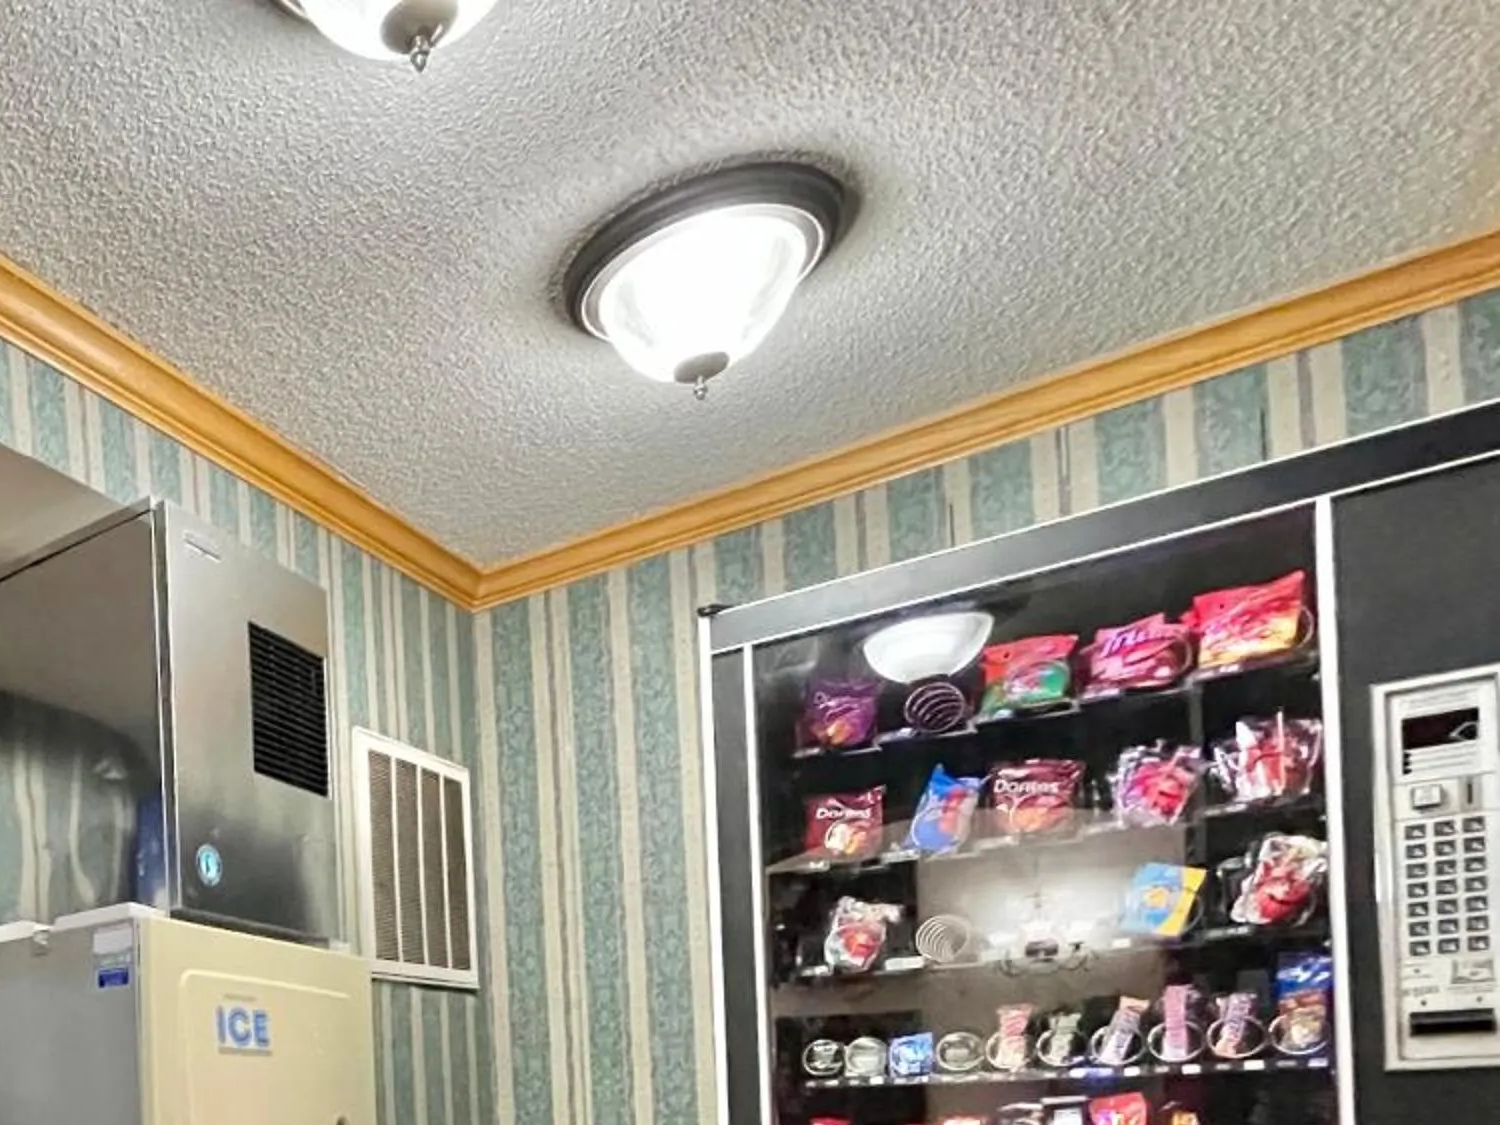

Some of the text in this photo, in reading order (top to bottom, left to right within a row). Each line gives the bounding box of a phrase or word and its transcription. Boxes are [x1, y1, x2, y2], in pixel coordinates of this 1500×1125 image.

[993, 779, 1061, 794] Doritos
[815, 806, 871, 820] Doritos
[216, 1005, 270, 1047] ICE
